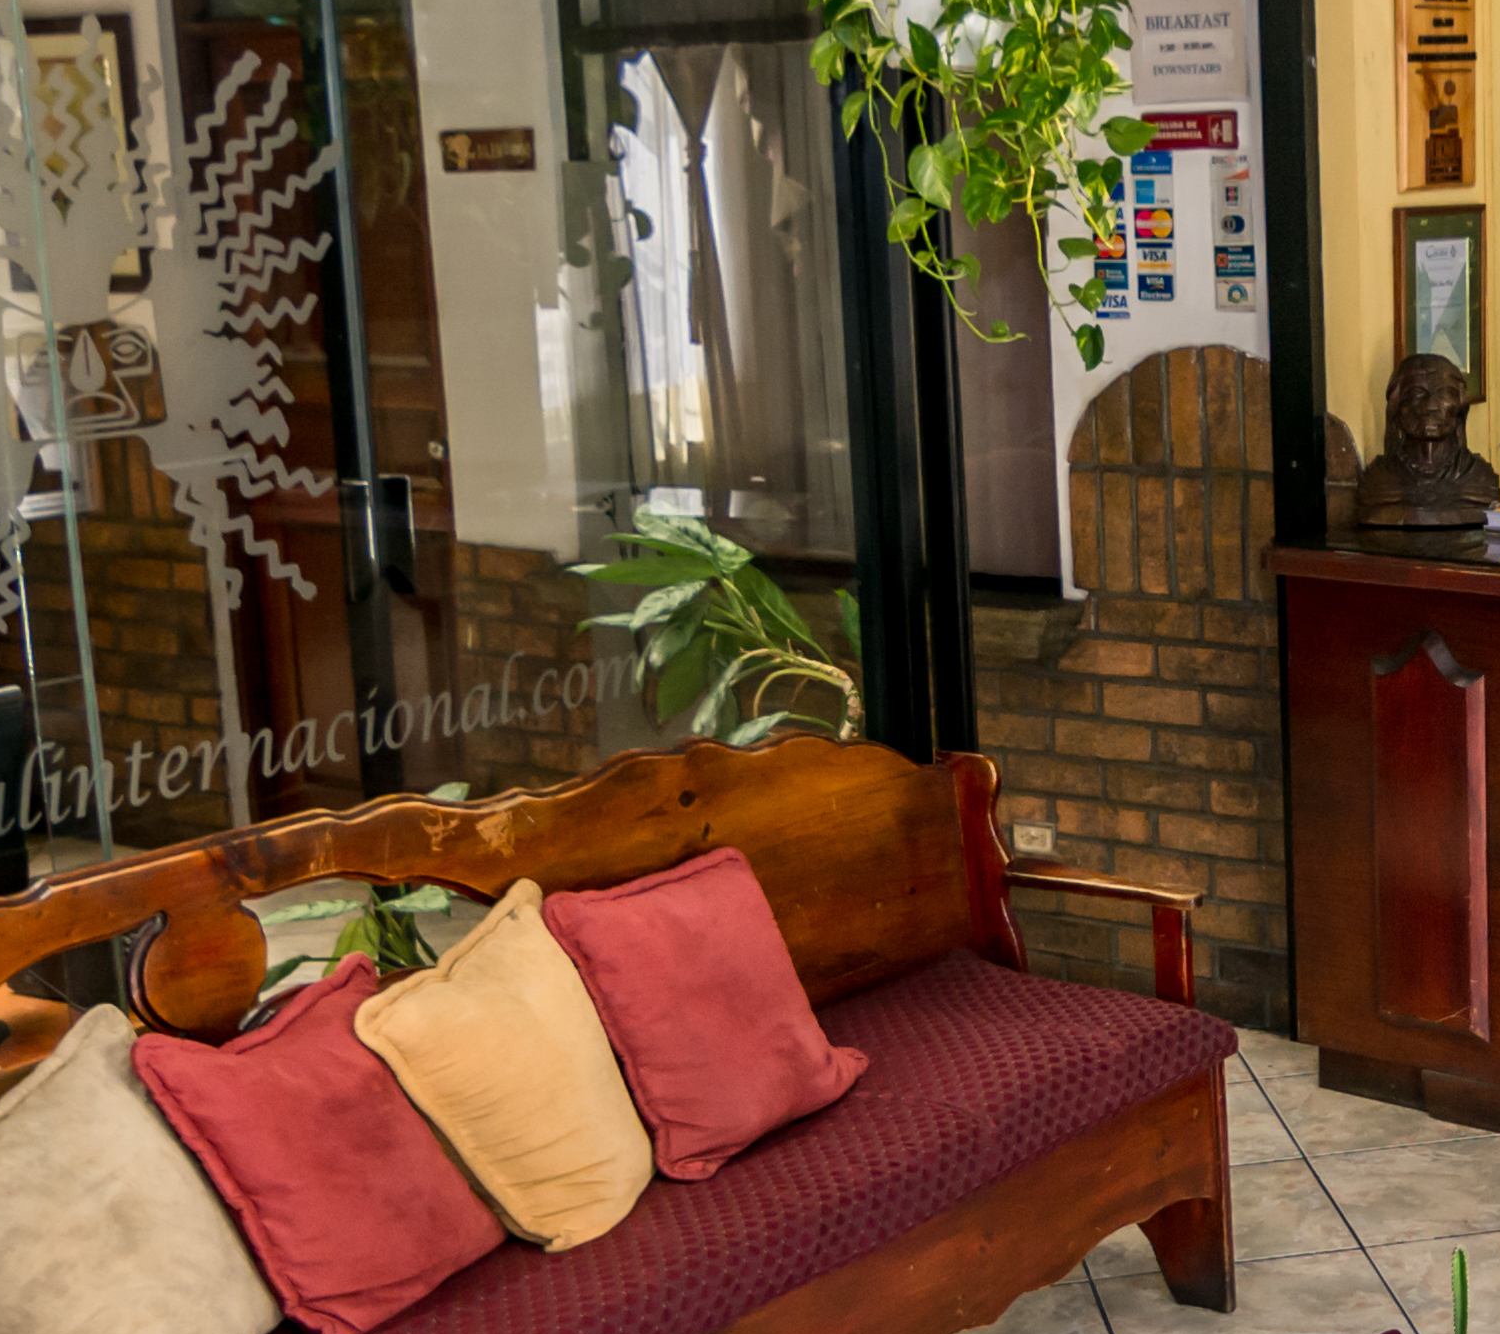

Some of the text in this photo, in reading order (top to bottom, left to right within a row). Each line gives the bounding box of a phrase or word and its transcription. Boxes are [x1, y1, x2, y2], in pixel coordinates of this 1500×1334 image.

[1145, 12, 1230, 31] BREAKFAST
[1153, 63, 1222, 77] DOWNSTAIRS
[1142, 250, 1167, 262] VISA
